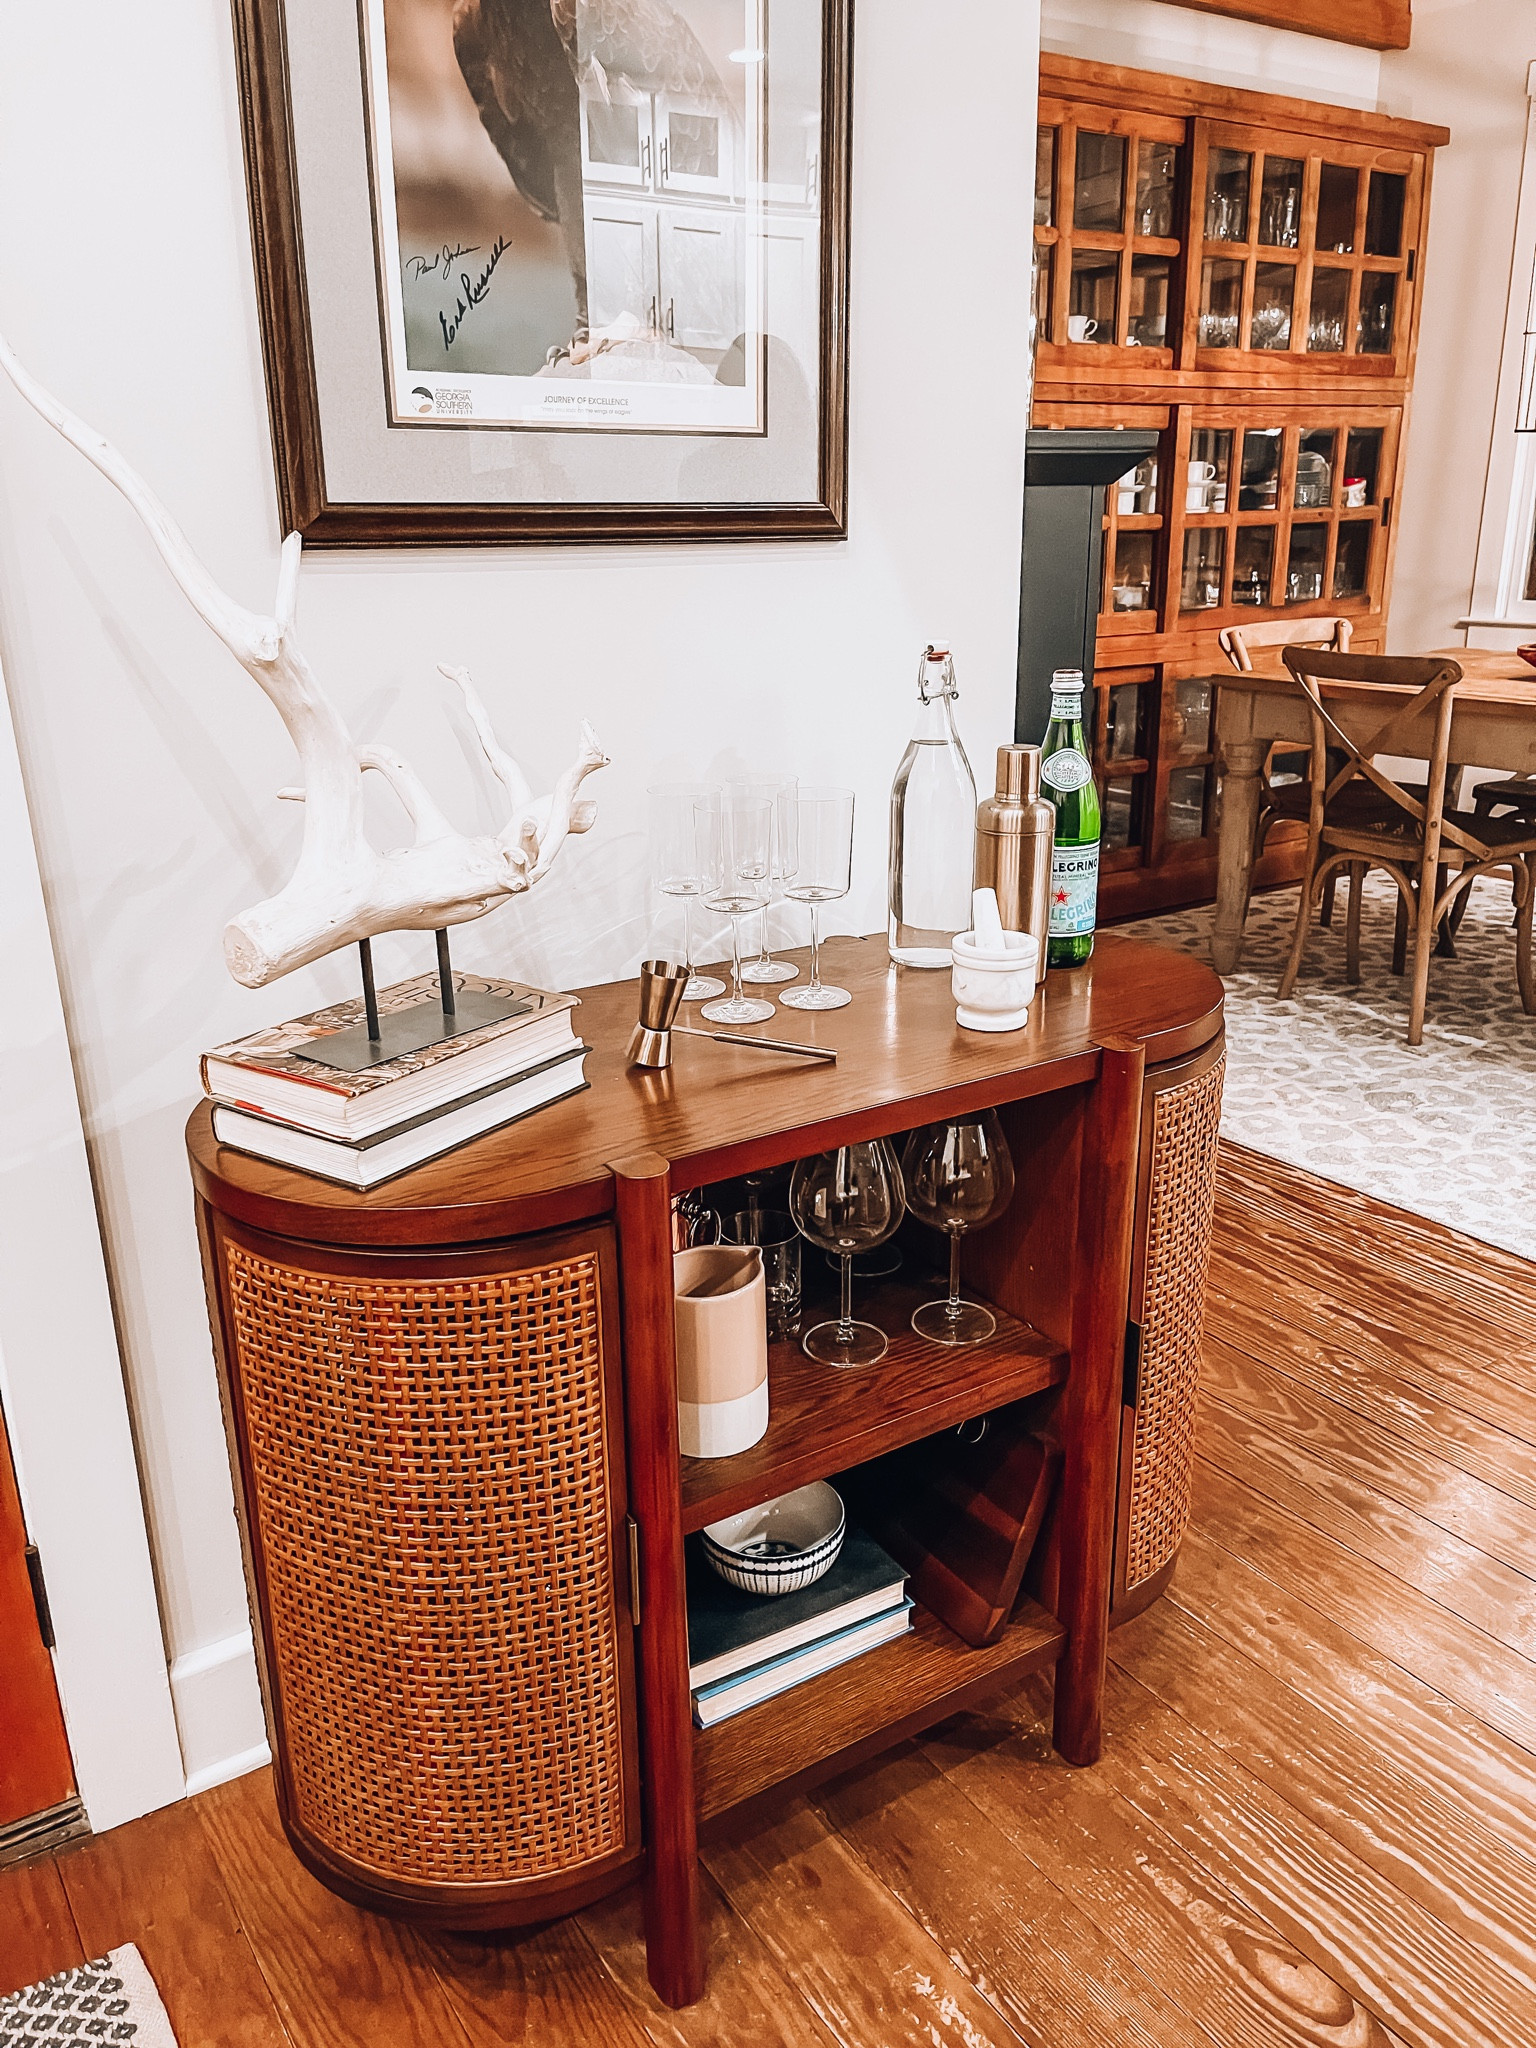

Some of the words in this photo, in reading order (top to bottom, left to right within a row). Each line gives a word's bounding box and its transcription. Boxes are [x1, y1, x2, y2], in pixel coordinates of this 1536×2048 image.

[435, 392, 471, 401] GEORGIA
[544, 395, 575, 404] JOURNEY
[577, 396, 587, 404] OF
[588, 397, 629, 406] EXCELLENCE
[436, 400, 473, 410] SOUTHERN
[1053, 858, 1098, 872] LEGRINO
[1050, 891, 1096, 921] LEGRINO
